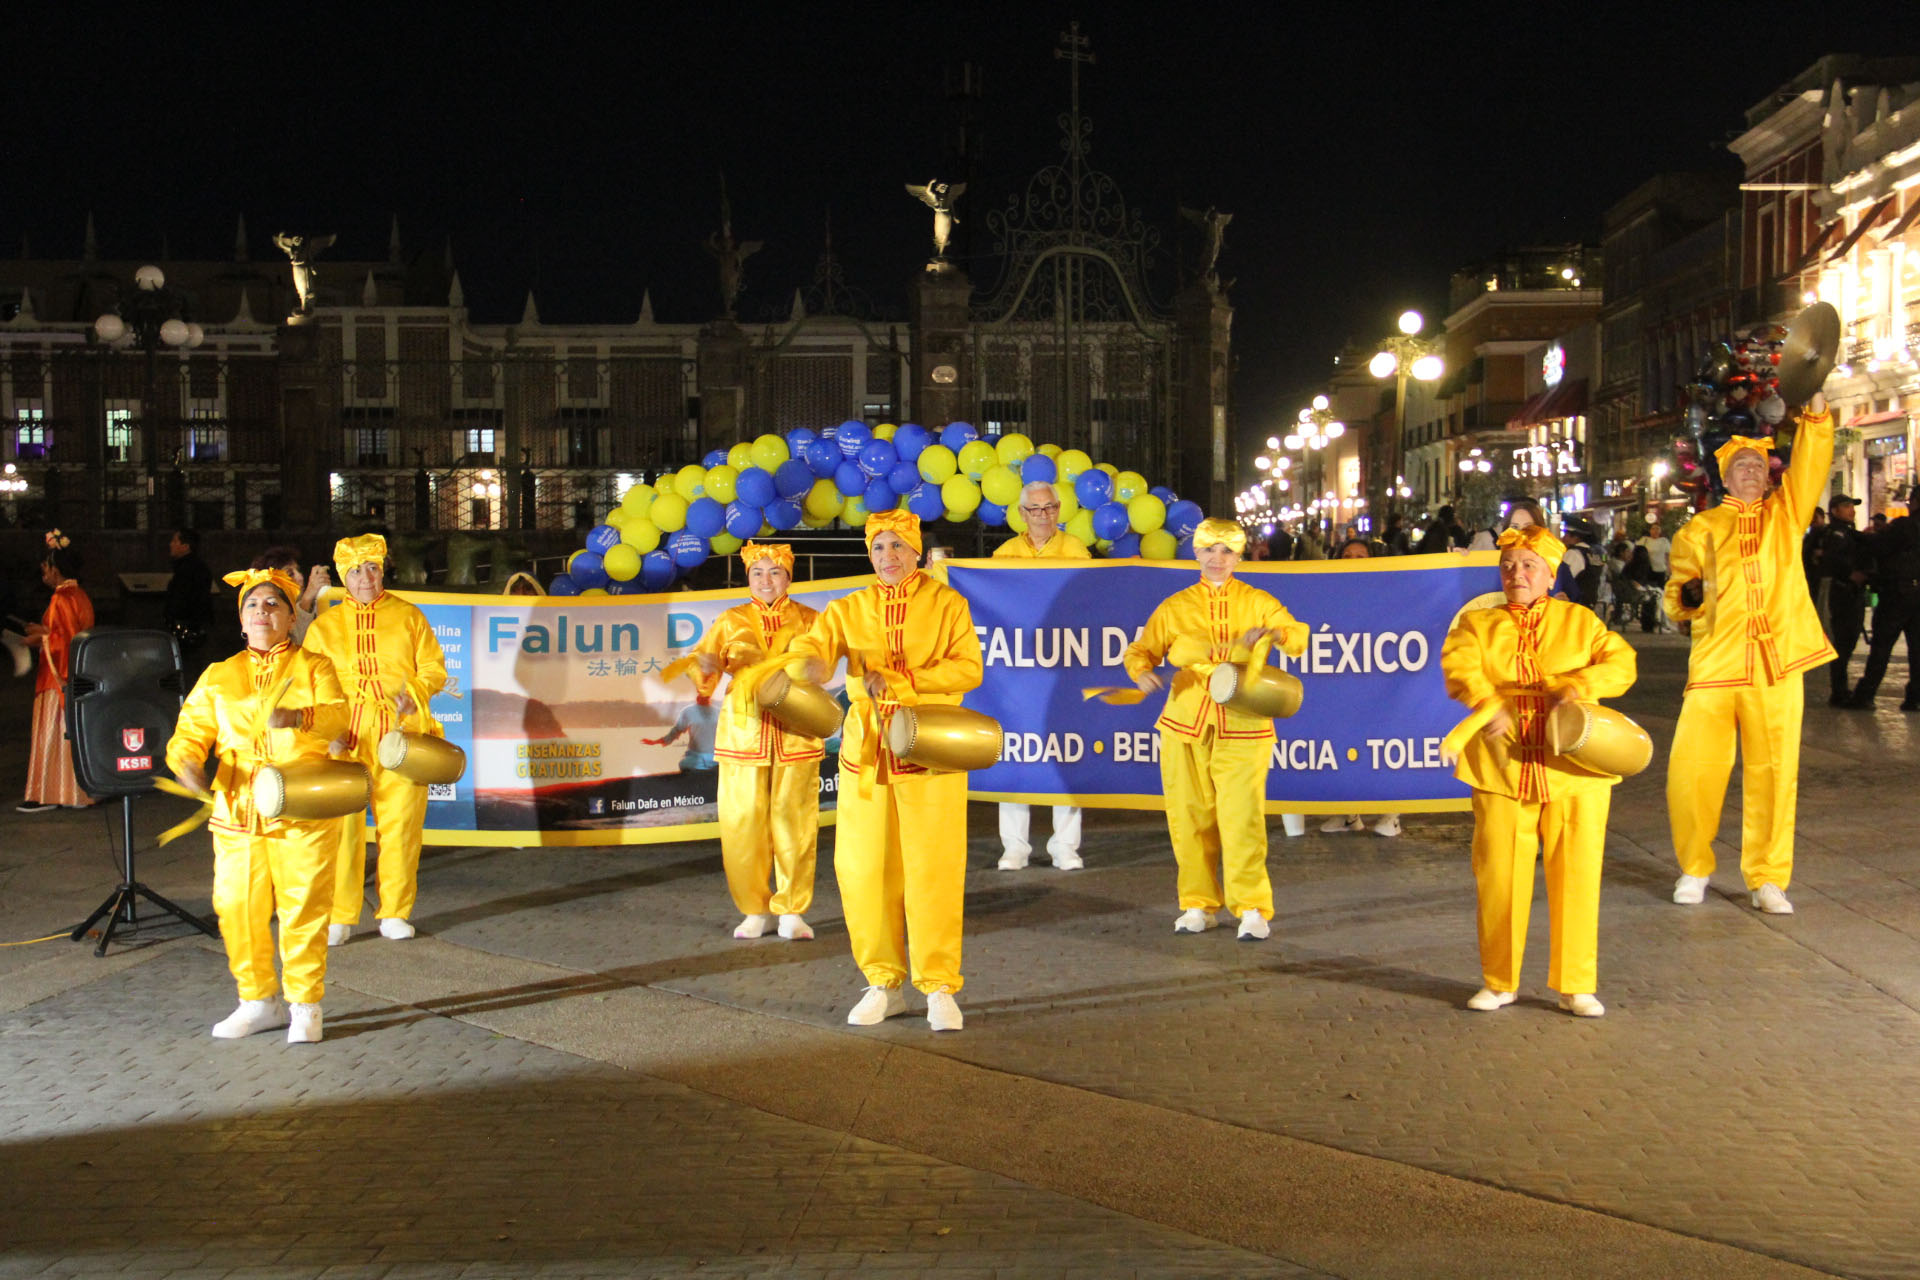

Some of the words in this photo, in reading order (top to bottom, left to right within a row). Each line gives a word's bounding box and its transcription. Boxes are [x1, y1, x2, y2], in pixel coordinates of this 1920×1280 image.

[488, 615, 640, 654] Falun
[587, 656, 672, 677] 法輪大
[431, 711, 463, 723] olerancia
[517, 741, 601, 759] ENSEÑANZAS
[1000, 731, 1084, 763] RDAD
[119, 757, 149, 769] KSR
[517, 760, 602, 778] GRATUITAS
[611, 799, 636, 811] Falun
[637, 798, 658, 810] Dafa
[660, 799, 672, 808] en
[673, 794, 705, 807] México
